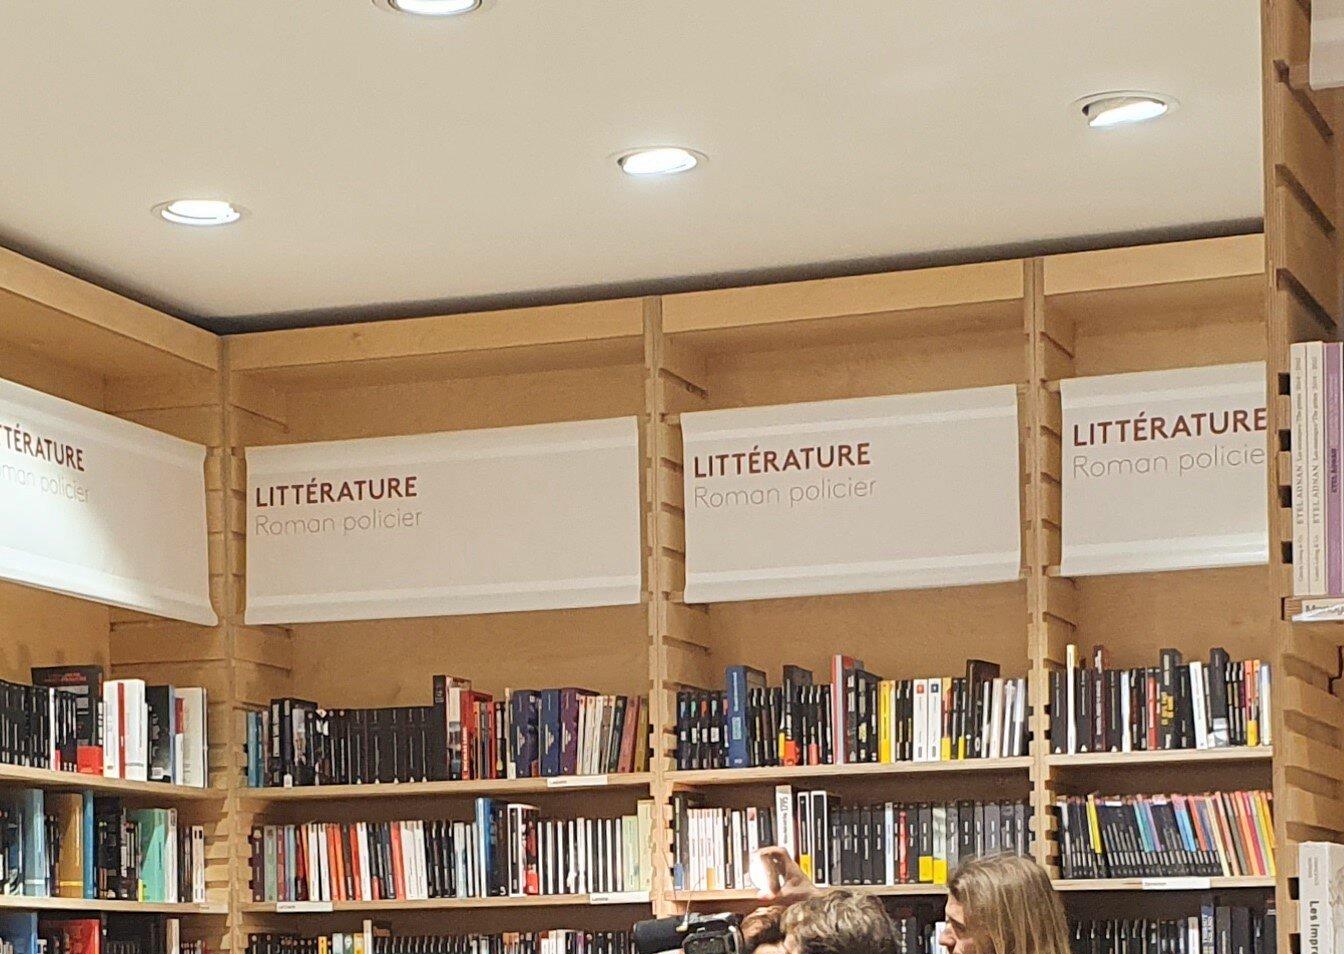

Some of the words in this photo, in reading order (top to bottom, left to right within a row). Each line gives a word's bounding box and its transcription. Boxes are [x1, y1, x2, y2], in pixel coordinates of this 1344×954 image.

[1073, 407, 1267, 447] LITTÉRATURE
[694, 442, 872, 478] LITTÉRATURE
[1073, 454, 1169, 480] Roman
[1179, 443, 1265, 477] policie
[40, 469, 89, 504] policier
[256, 475, 418, 508] LITTÉRATURE
[694, 484, 780, 509] Roman
[790, 477, 877, 509] policier
[256, 512, 336, 537] Roman
[342, 507, 423, 538] policier
[1308, 900, 1320, 921] Les
